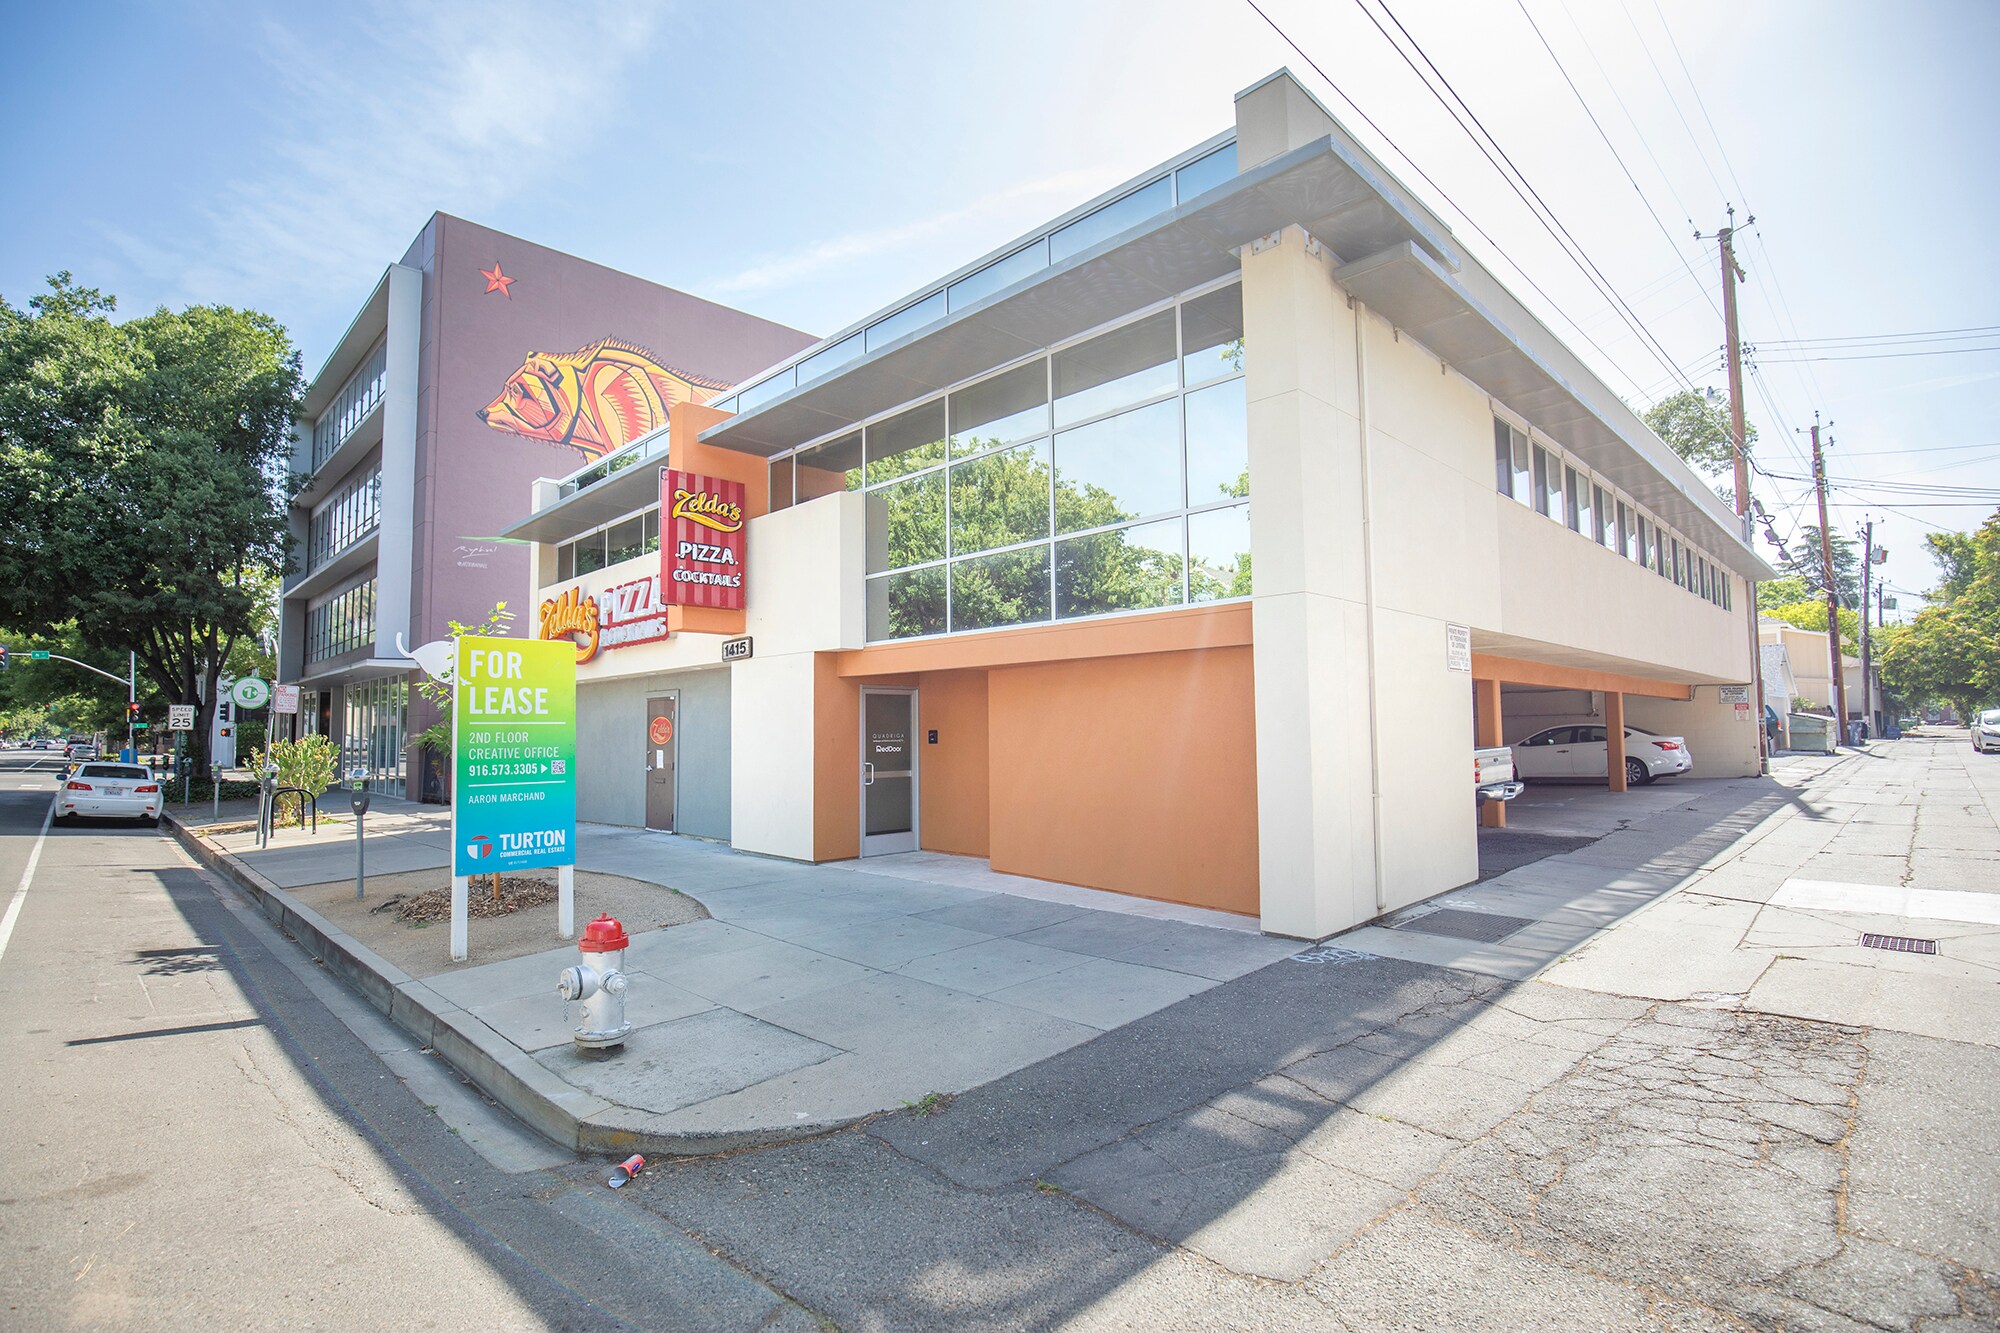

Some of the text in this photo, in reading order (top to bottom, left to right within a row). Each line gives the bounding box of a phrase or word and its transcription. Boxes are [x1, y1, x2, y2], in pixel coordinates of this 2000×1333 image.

[672, 488, 743, 533] Zelda's
[679, 541, 735, 565] PIZZA
[672, 568, 741, 588] COCKTAILS
[539, 574, 666, 664] Zelda's PIZZA
[724, 642, 746, 658] 1415
[470, 650, 523, 679] FOR
[469, 687, 549, 714] LEASE
[172, 718, 191, 728] 25
[469, 731, 529, 744] 2ND FLOOR
[468, 746, 559, 760] CREATIVE OFFICE
[469, 763, 538, 777] 916.573.3305
[468, 791, 546, 804] AARON MARCHAND
[499, 829, 566, 851] TURTON
[499, 849, 532, 858] COMMERCIAL
